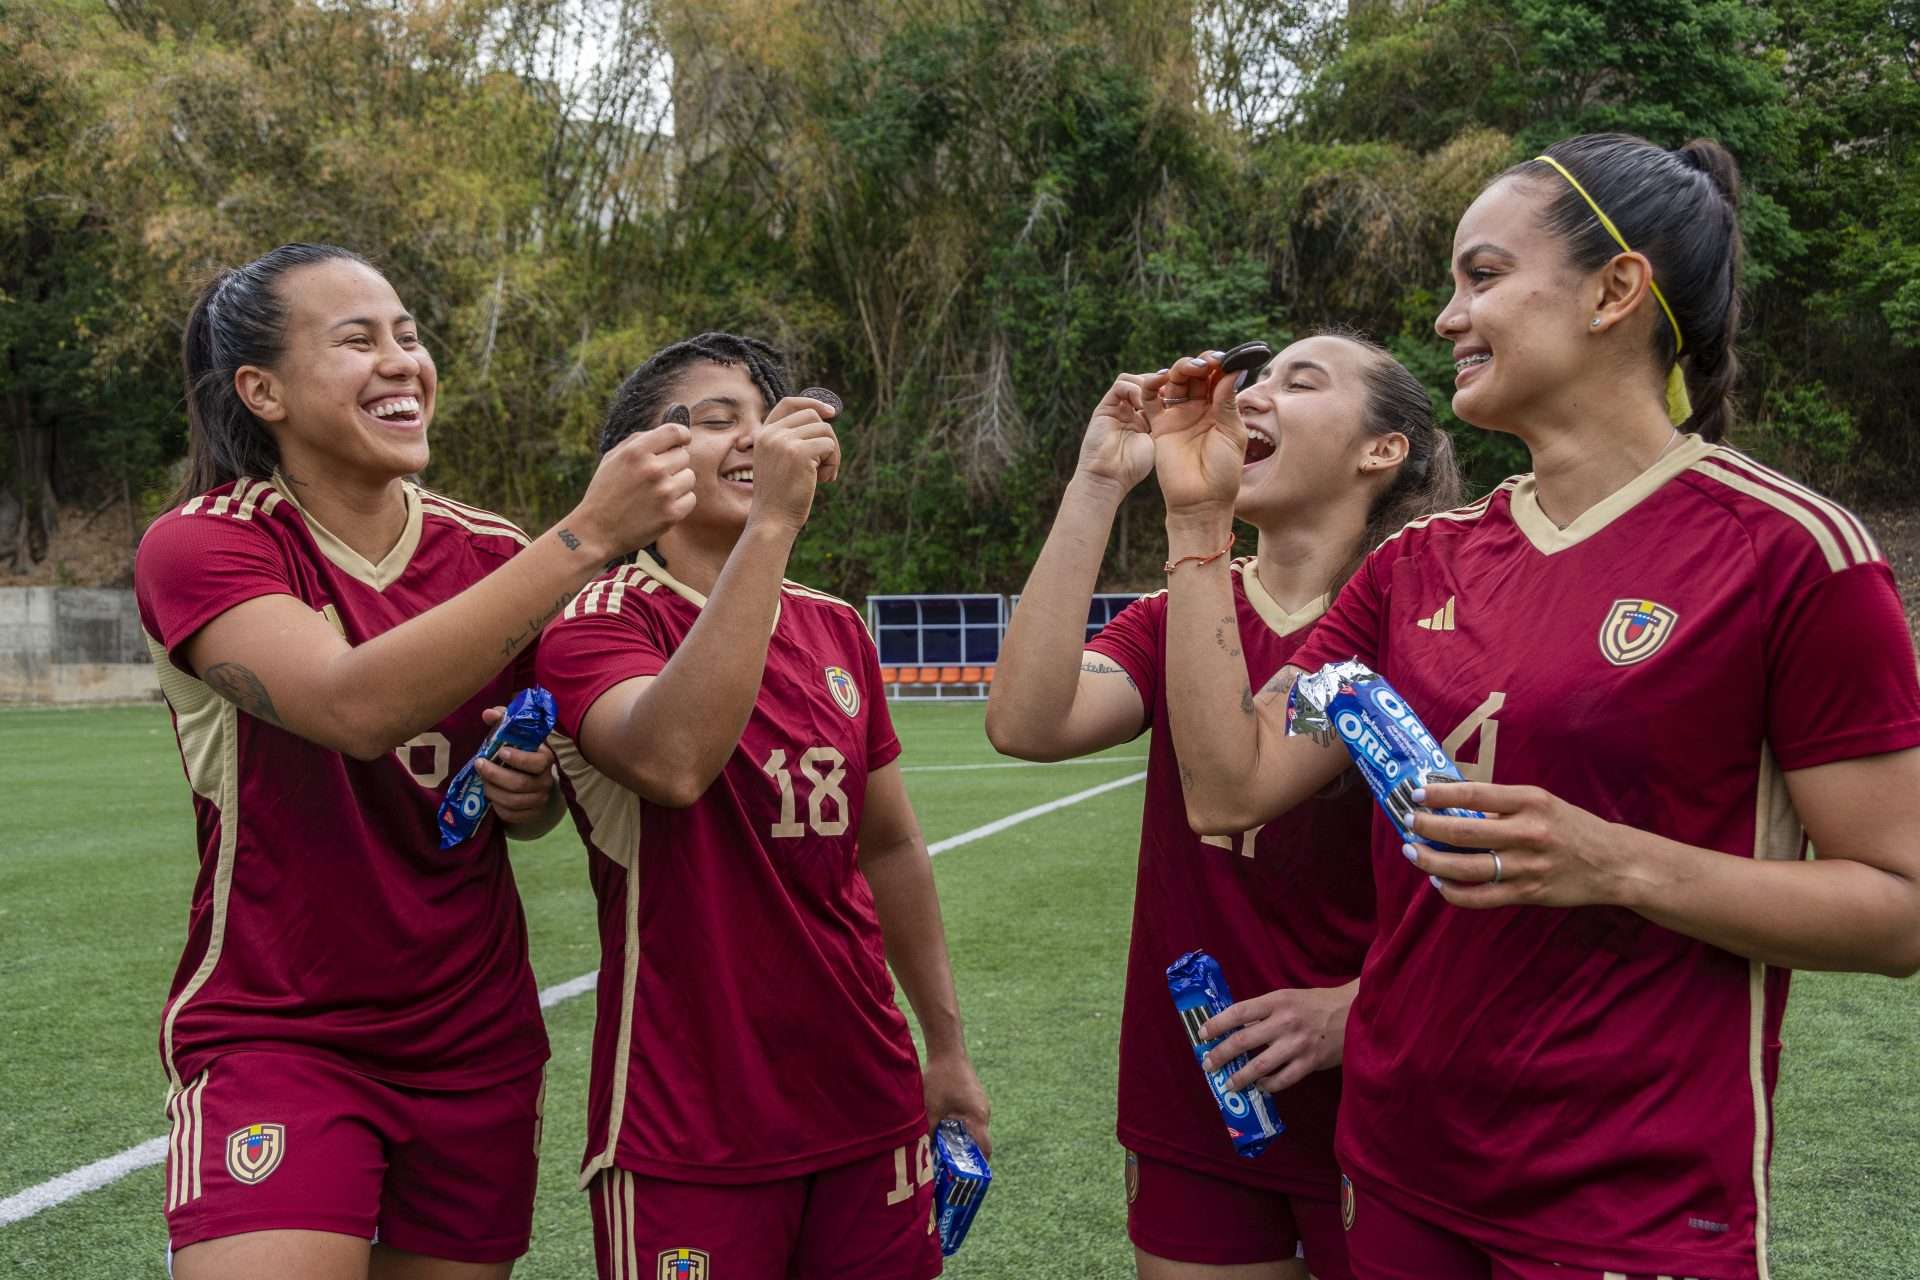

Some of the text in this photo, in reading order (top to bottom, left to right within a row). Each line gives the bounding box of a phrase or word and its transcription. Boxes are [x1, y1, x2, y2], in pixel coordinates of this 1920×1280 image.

[1338, 712, 1399, 778] OREO
[1376, 689, 1446, 770] OREO
[1441, 691, 1507, 784] 4
[762, 747, 849, 838] 18
